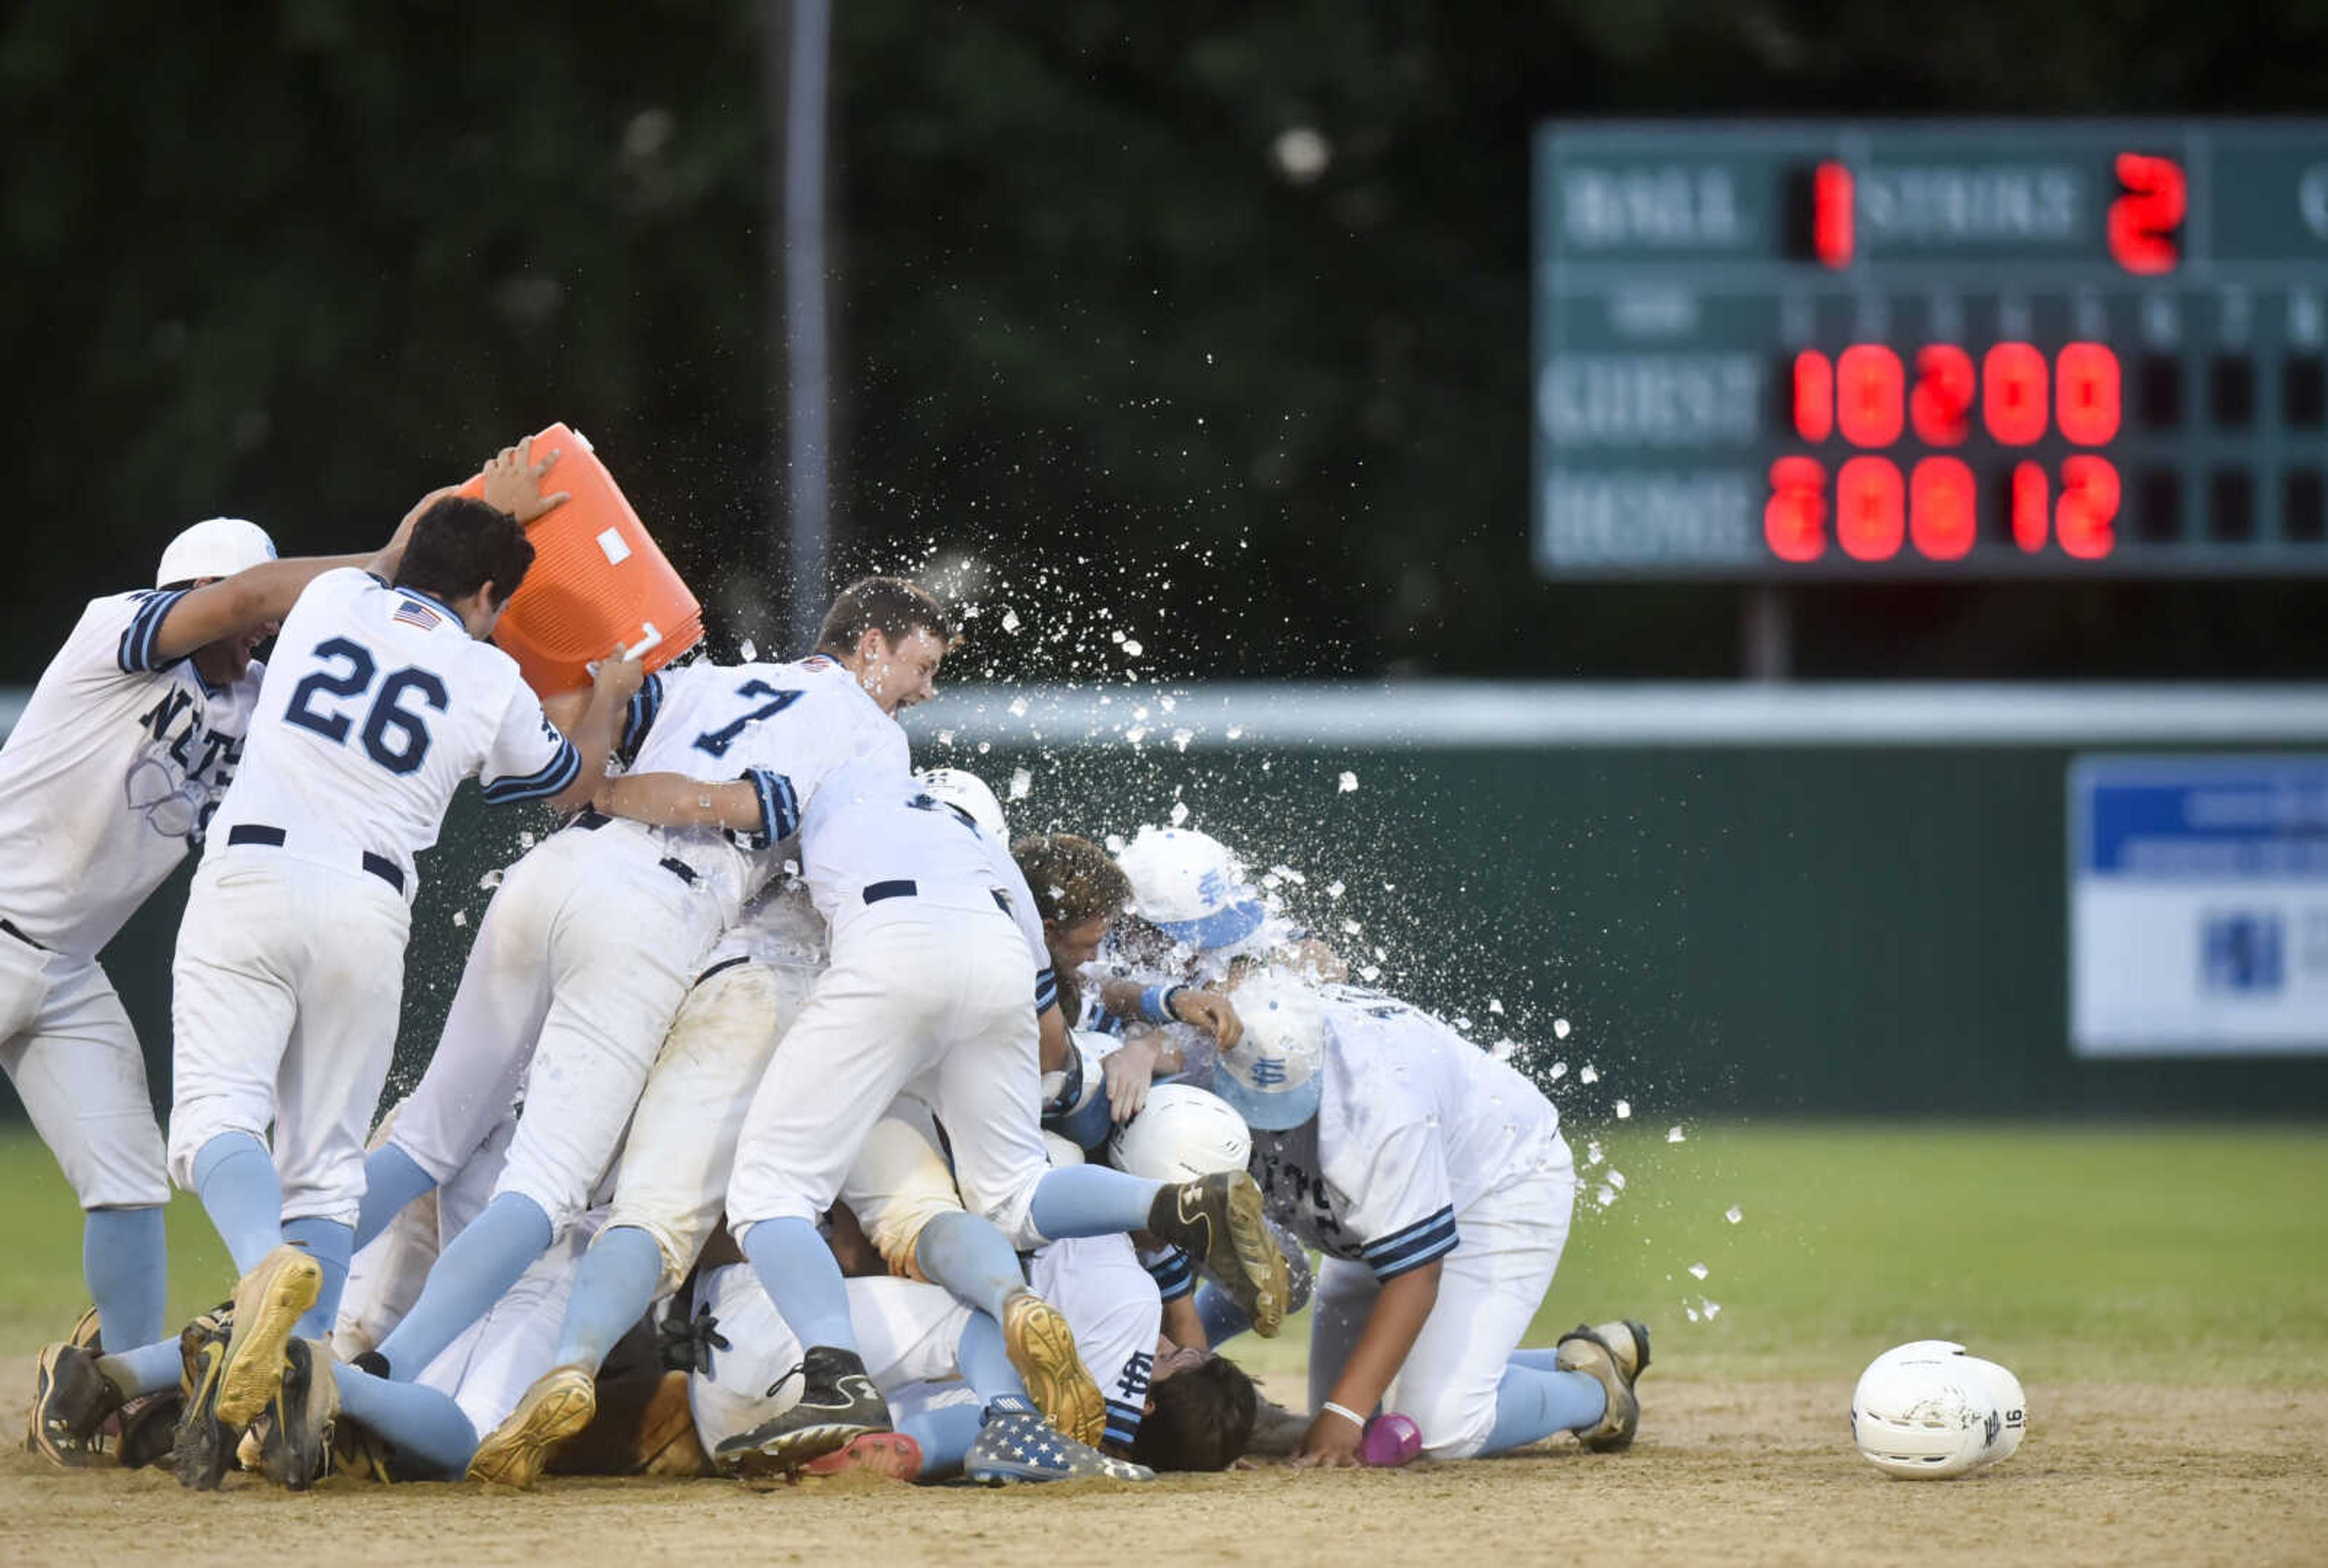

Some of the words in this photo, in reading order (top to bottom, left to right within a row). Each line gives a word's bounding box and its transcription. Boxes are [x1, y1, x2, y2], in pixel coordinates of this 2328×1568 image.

[1814, 160, 1854, 270] 1
[2107, 152, 2186, 276] 2
[283, 636, 449, 776] 26
[691, 679, 806, 759] 7
